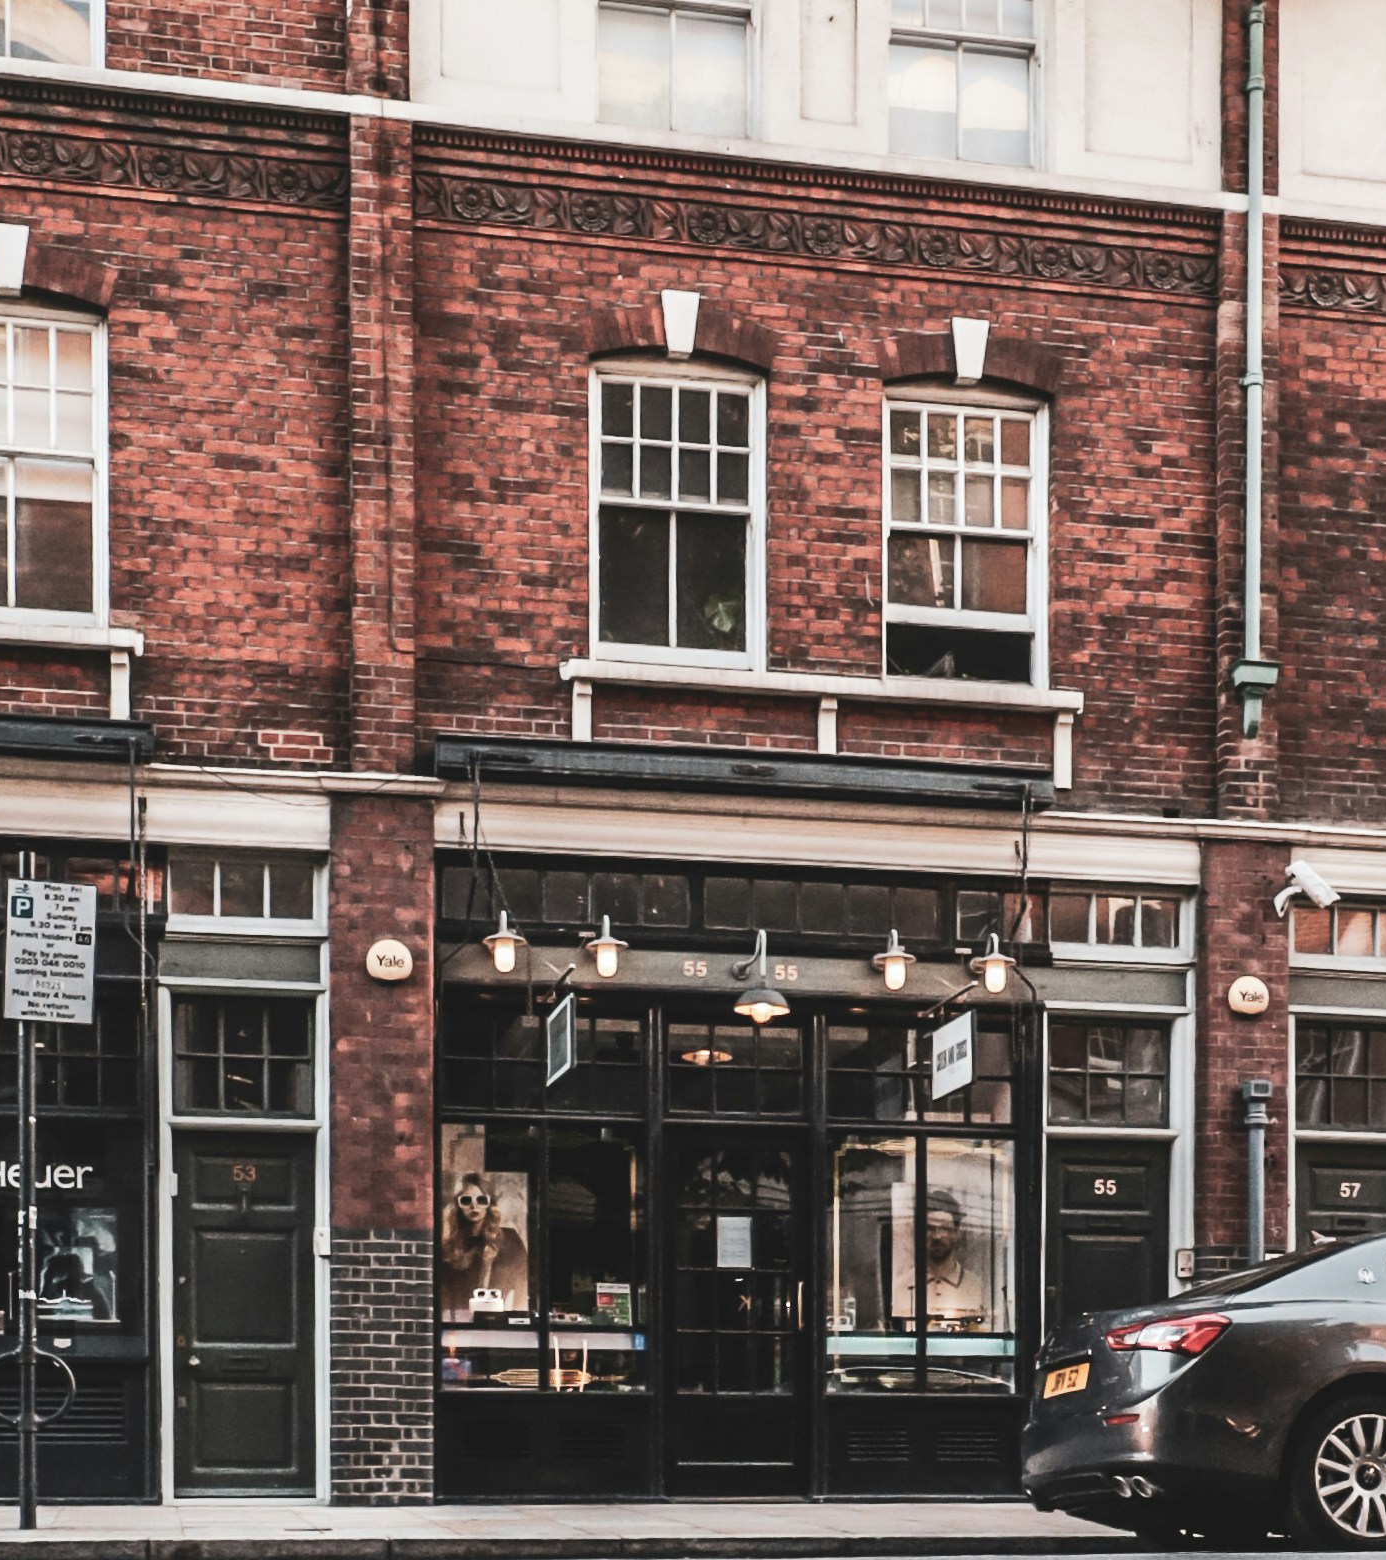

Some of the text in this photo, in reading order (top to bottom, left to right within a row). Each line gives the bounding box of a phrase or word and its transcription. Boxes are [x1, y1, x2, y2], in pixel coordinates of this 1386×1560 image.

[16, 898, 31, 916] P
[46, 913, 77, 922] Sunday
[11, 930, 38, 939] Permit
[42, 933, 72, 941] holders
[22, 949, 37, 957] Pay
[376, 955, 405, 968] Yale
[15, 969, 84, 978] quoting location
[683, 960, 707, 978] 55
[775, 965, 798, 981] 55
[1240, 991, 1264, 1003] Yale
[233, 1166, 255, 1181] 53
[1094, 1179, 1116, 1195] 55
[1340, 1183, 1361, 1198] 57
